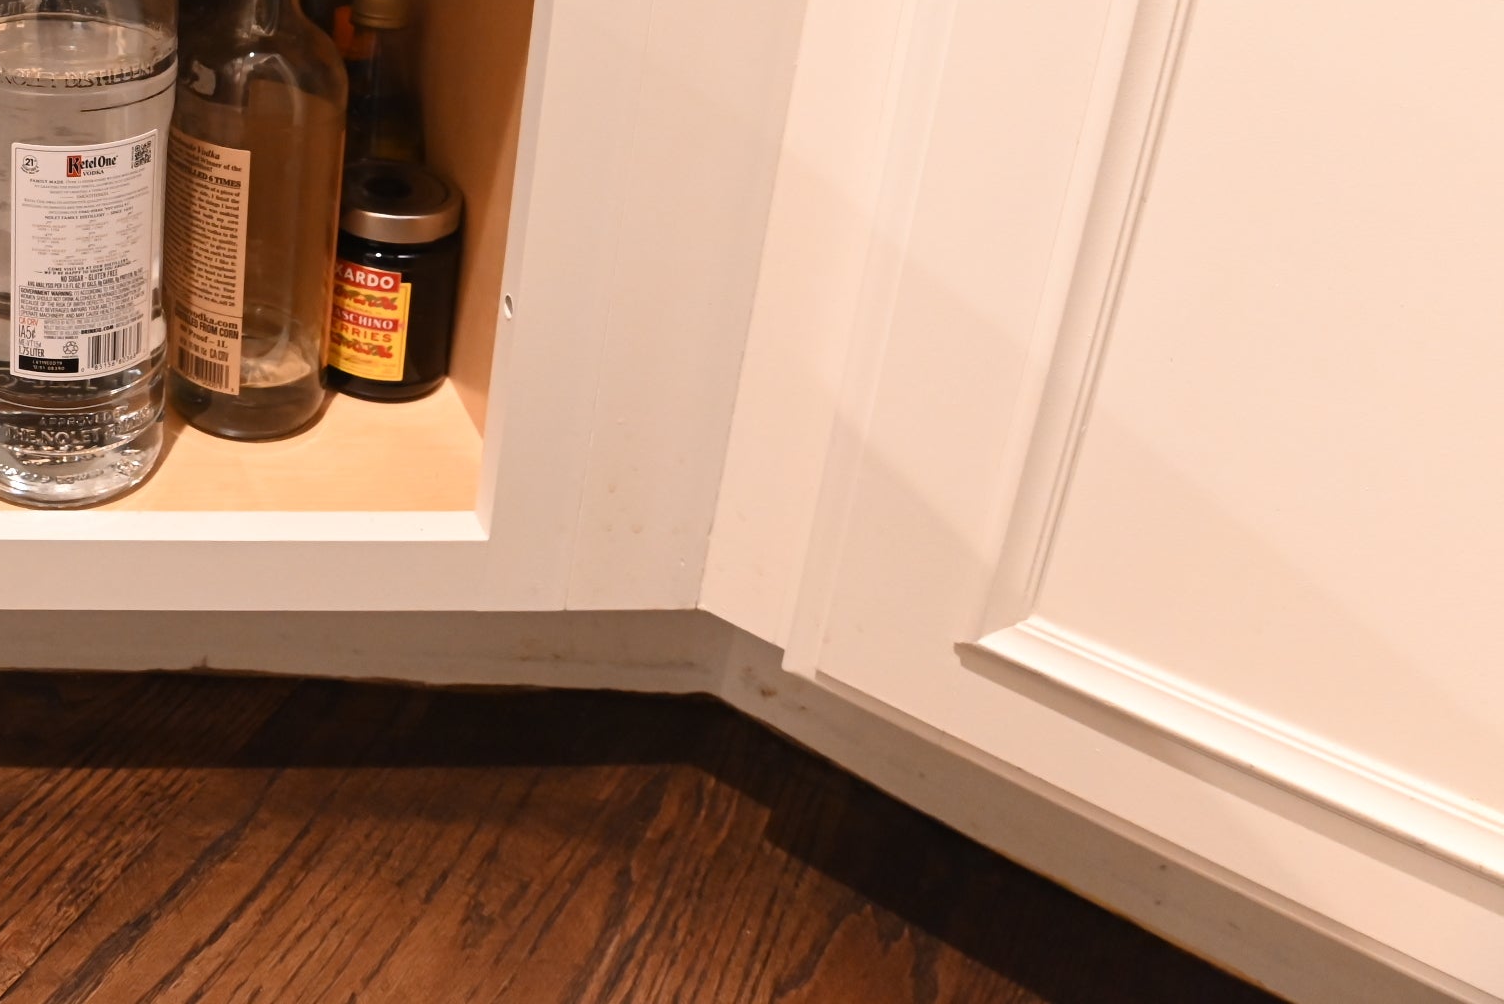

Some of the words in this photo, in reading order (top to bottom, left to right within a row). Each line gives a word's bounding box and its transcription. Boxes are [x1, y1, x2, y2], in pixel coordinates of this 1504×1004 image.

[198, 146, 220, 160] Vodka
[68, 156, 97, 176] Ketel
[98, 156, 116, 166] One
[200, 158, 221, 168] Winner
[214, 177, 241, 187] TIMES
[88, 272, 106, 281] GLUTEN
[107, 269, 118, 277] FREE
[188, 329, 207, 343] Proof
[200, 322, 217, 336] FROM
[219, 328, 239, 340] CORN
[30, 348, 45, 357] LITER
[209, 348, 217, 358] CA
